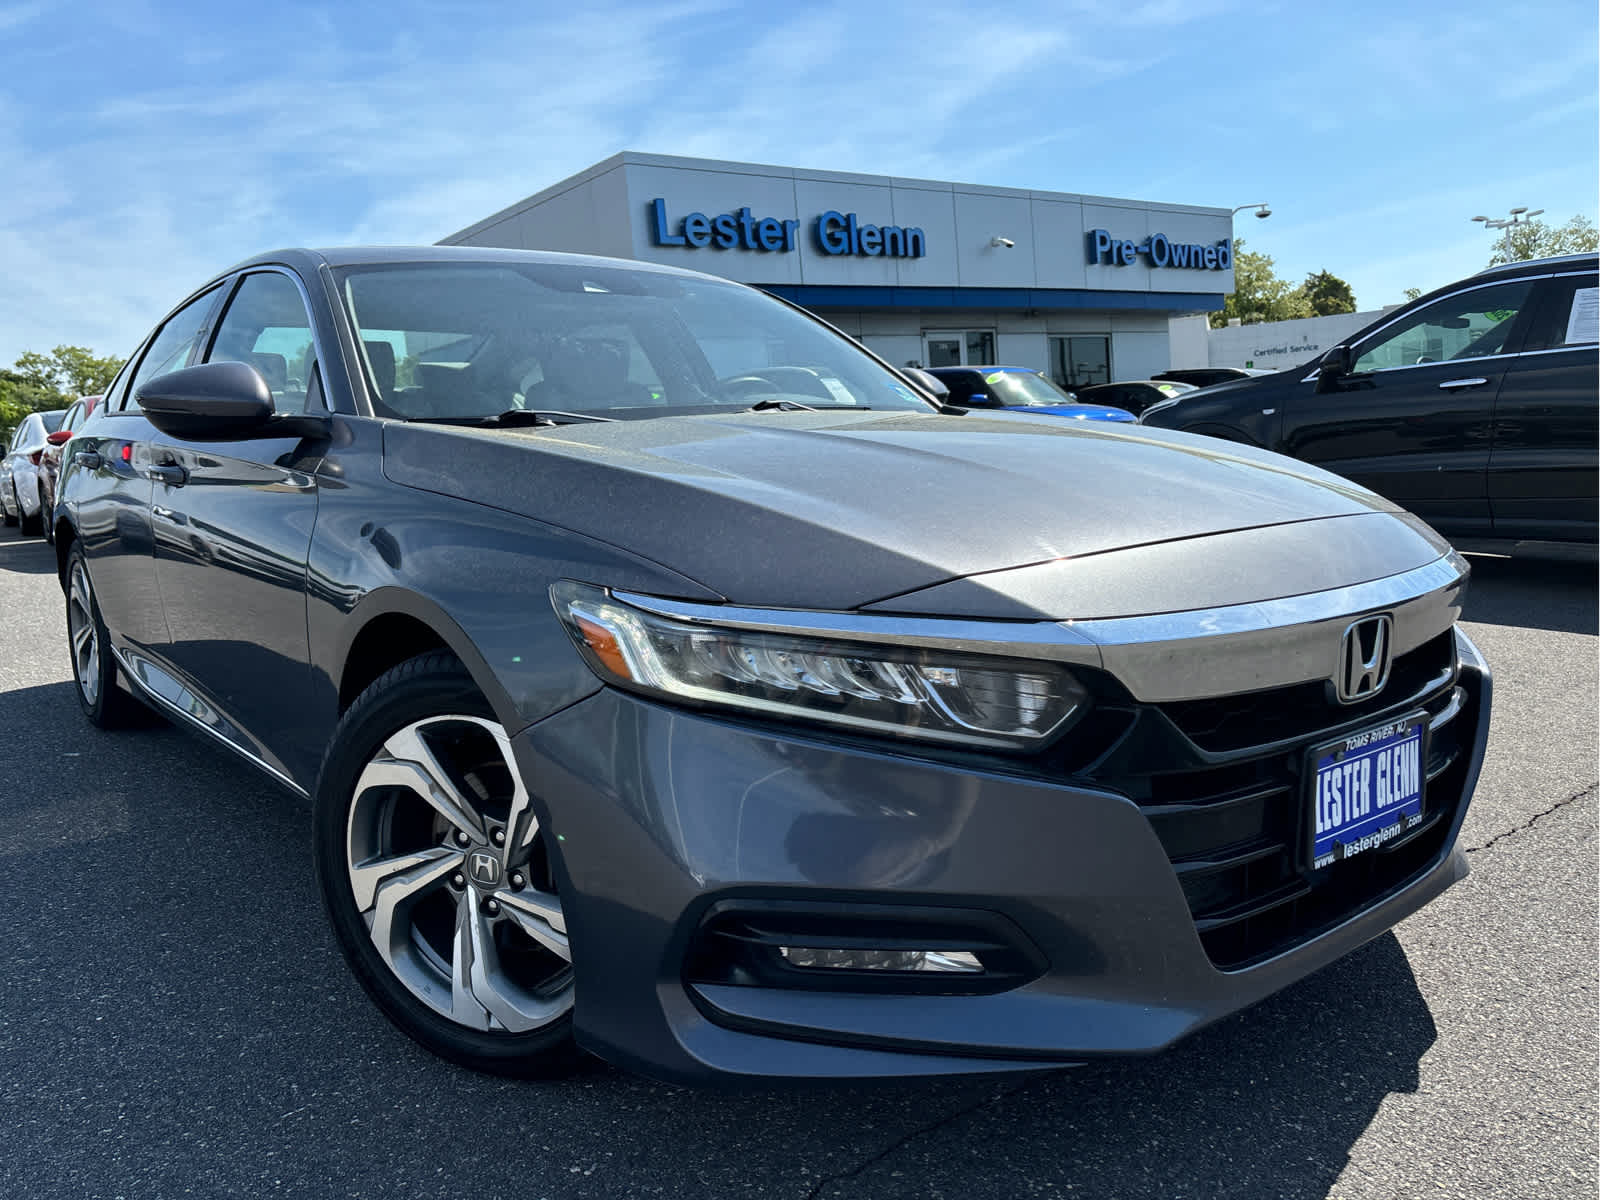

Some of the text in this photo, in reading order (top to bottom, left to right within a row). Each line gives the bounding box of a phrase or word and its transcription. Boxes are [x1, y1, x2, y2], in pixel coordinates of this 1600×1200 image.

[652, 197, 926, 257] Lester Glenn
[1089, 228, 1232, 270] Pre-Owned
[1254, 344, 1319, 357] Certified Service
[1345, 734, 1369, 752] TOMS
[1315, 739, 1419, 834] LESTER GLENN
